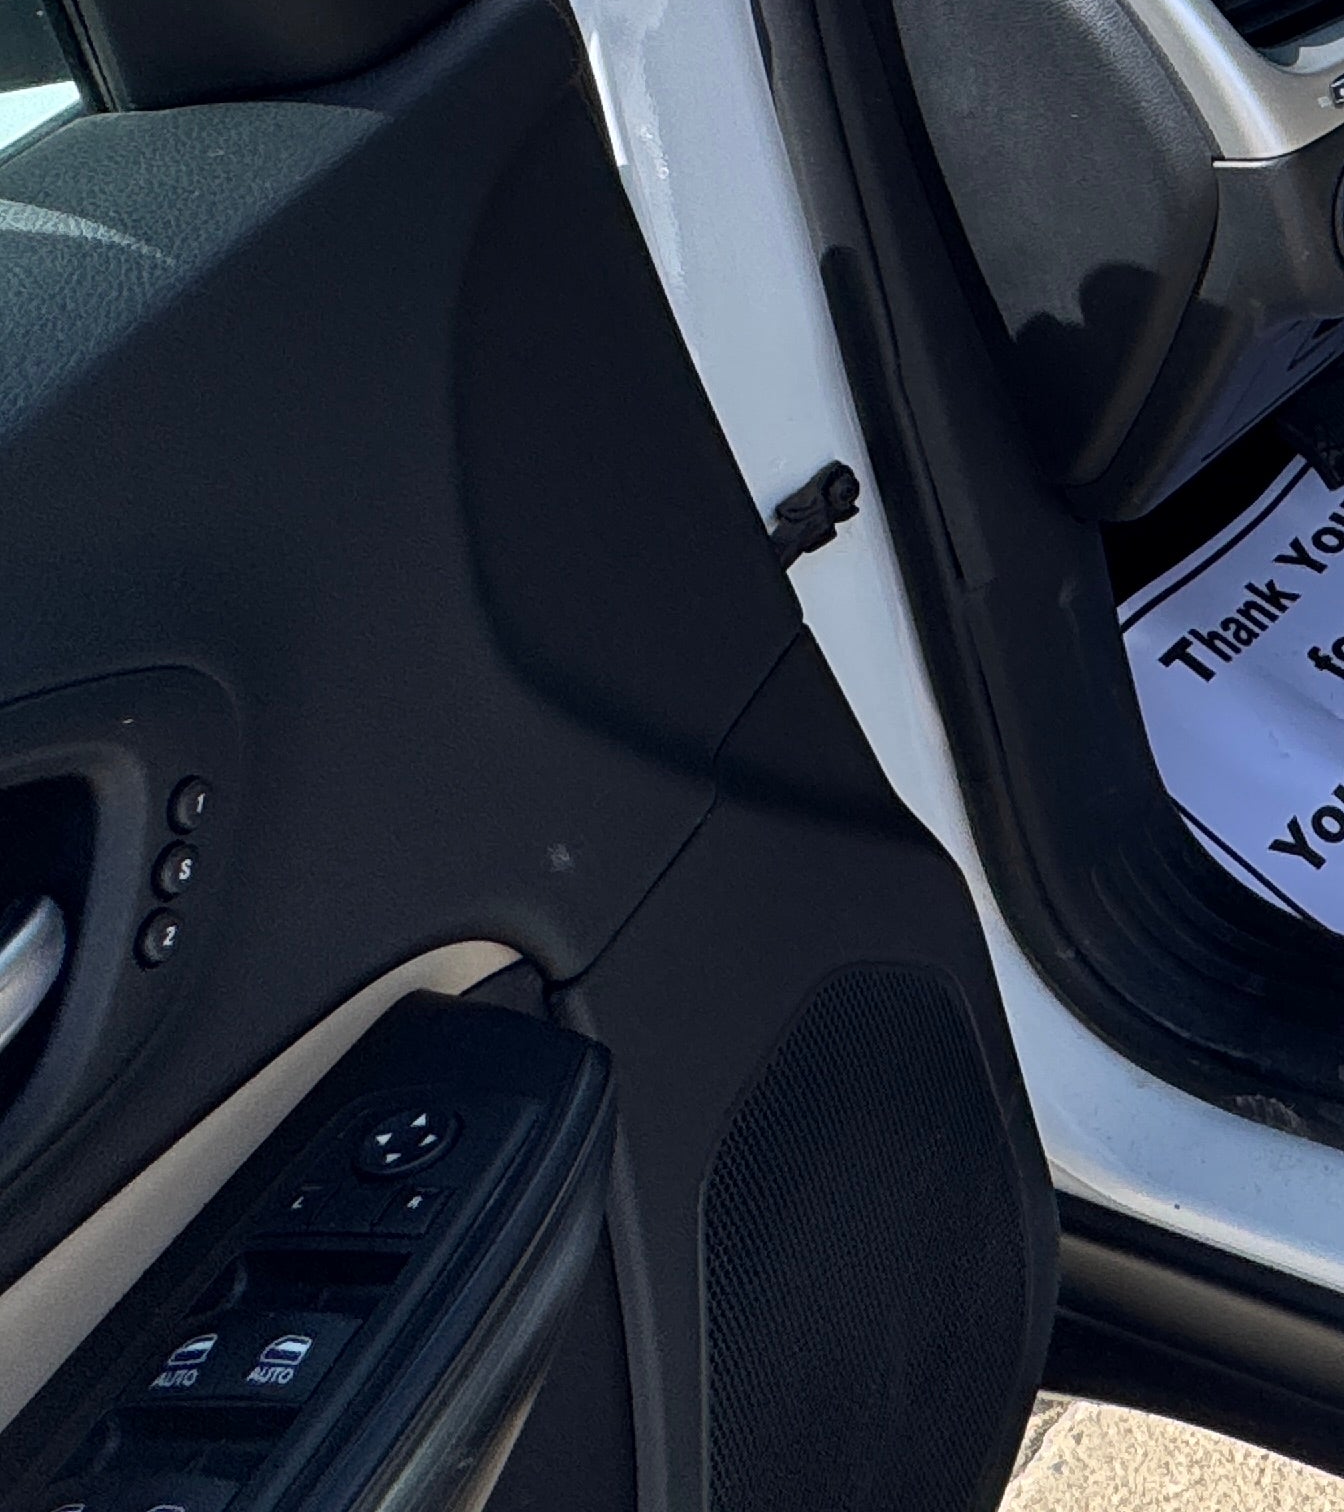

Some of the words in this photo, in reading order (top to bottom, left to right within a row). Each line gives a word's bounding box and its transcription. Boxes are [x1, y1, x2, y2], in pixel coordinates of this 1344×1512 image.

[1157, 578, 1302, 683] Thank
[196, 792, 207, 815] 1
[178, 858, 193, 881] S
[162, 925, 177, 948] 2
[150, 1369, 199, 1388] AUTO
[247, 1367, 295, 1385] AUTO
